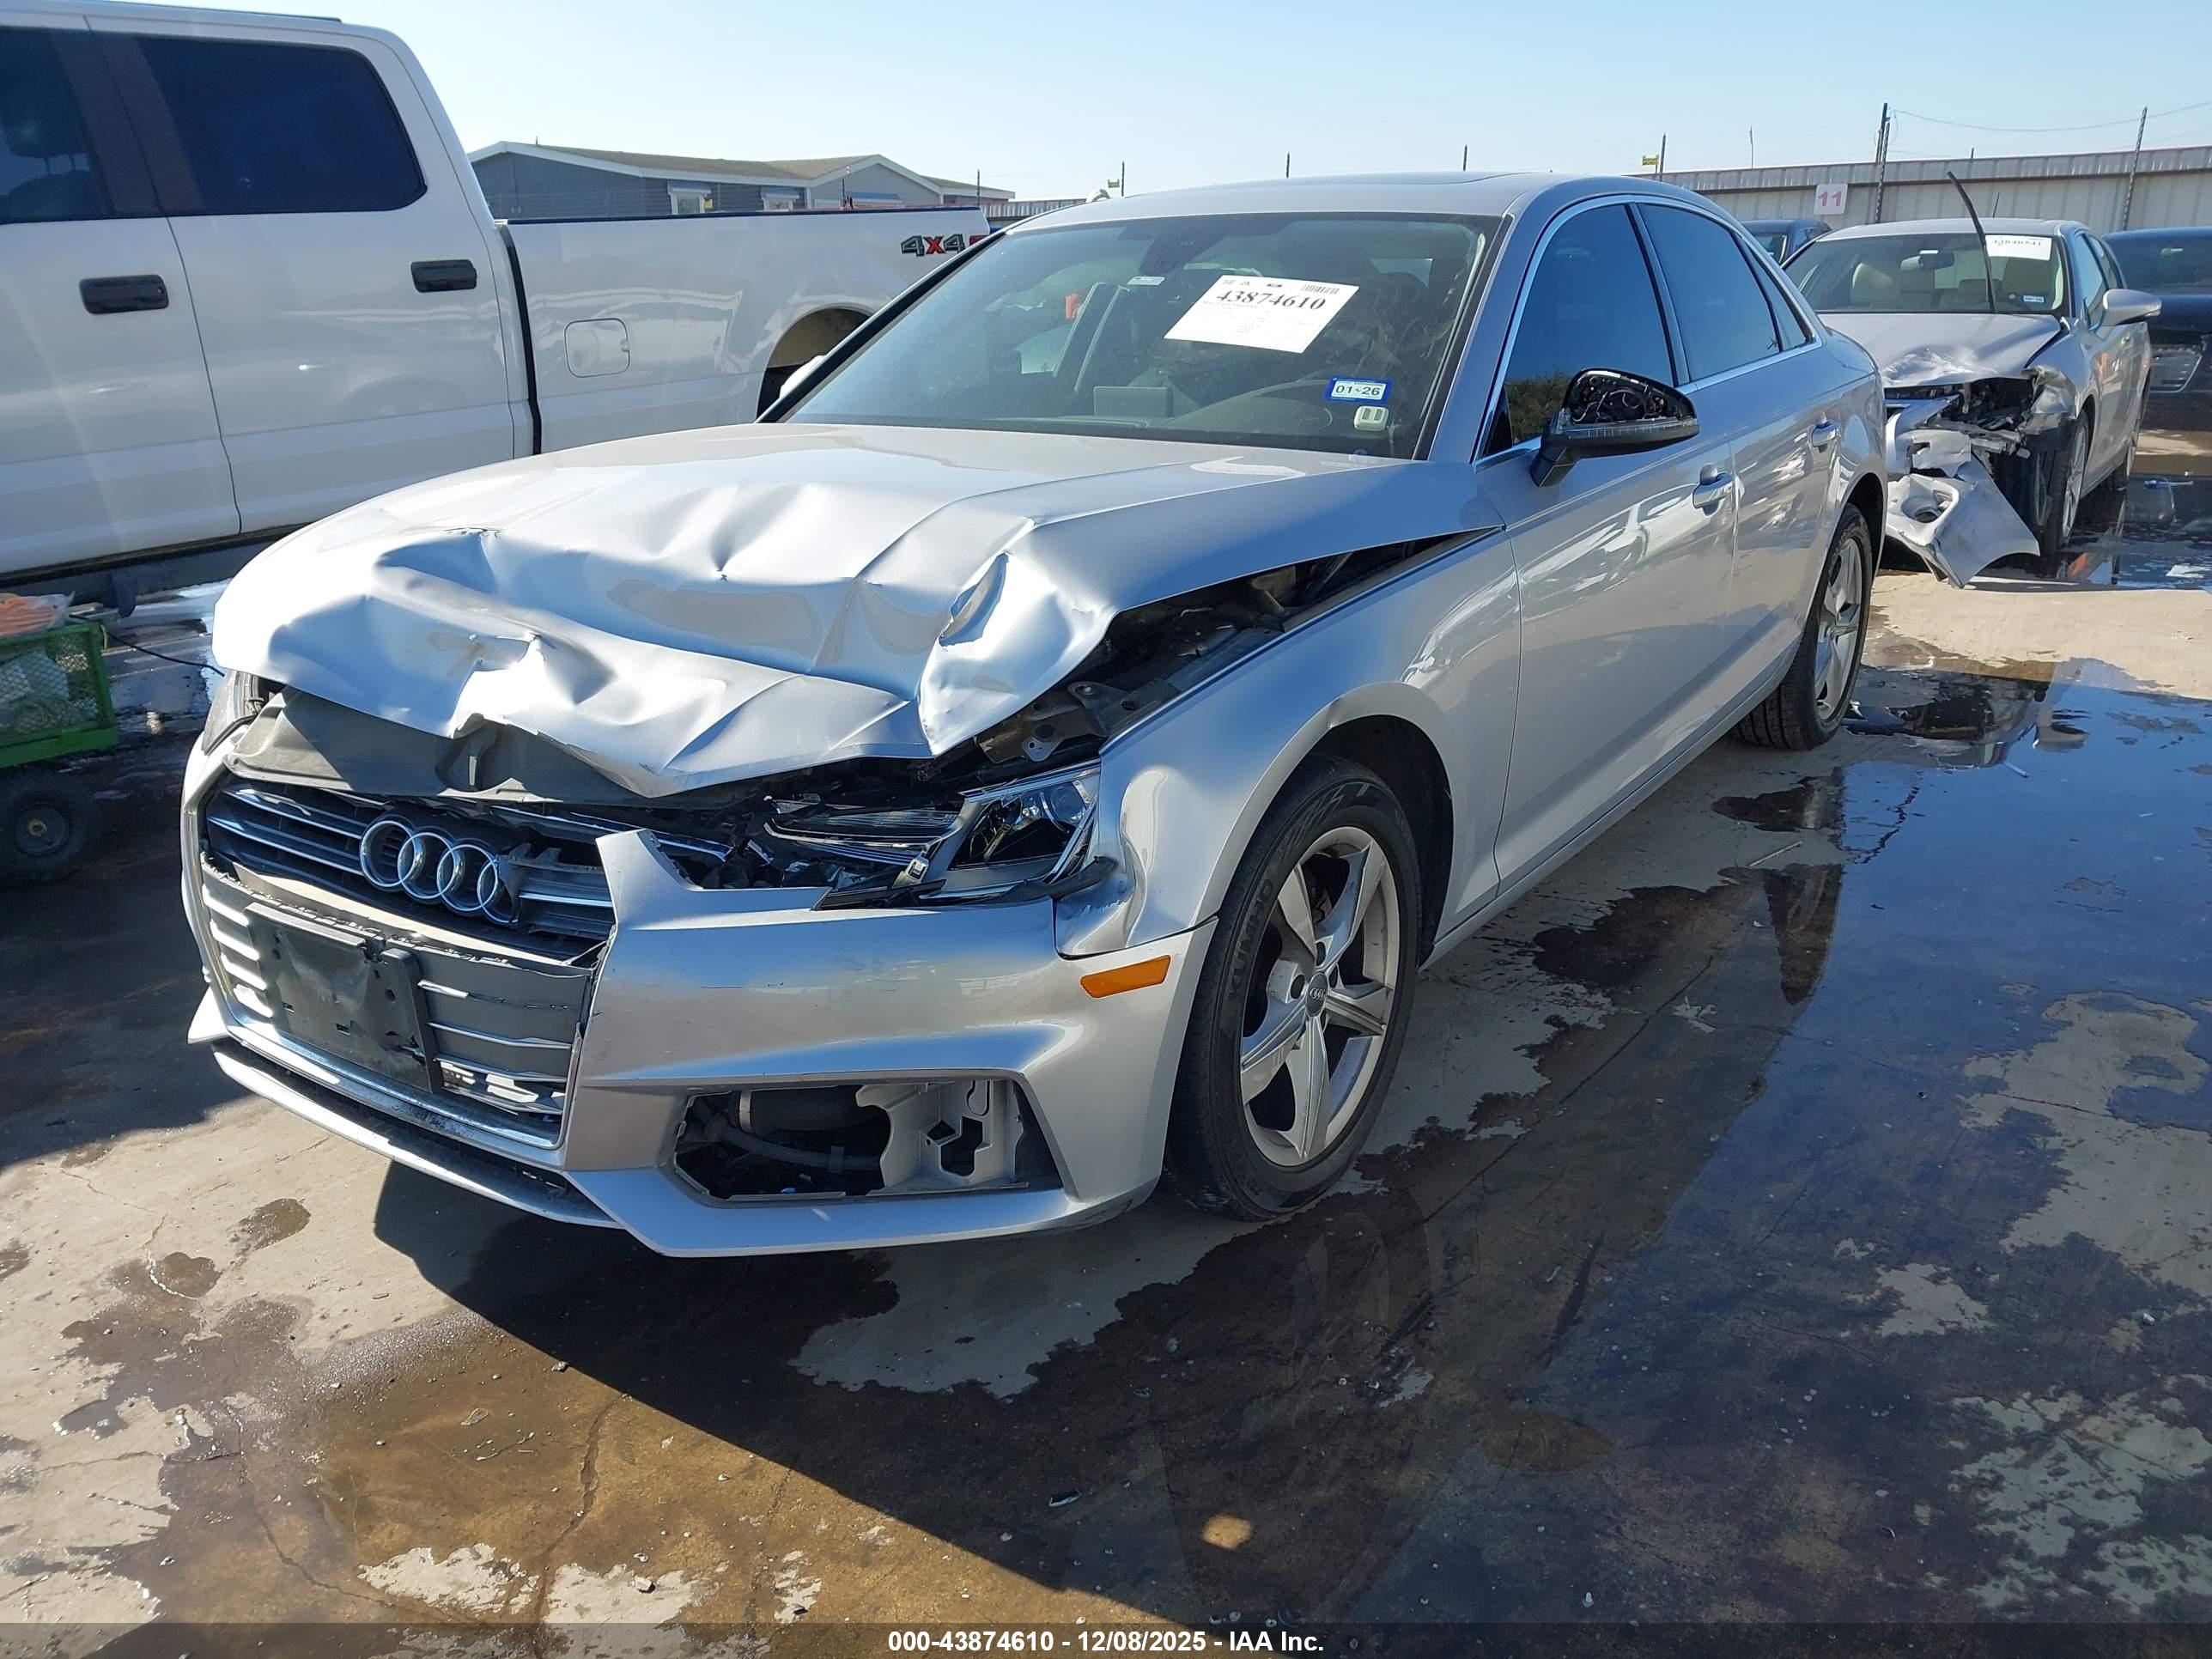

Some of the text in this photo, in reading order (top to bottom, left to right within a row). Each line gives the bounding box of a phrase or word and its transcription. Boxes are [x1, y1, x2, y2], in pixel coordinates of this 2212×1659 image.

[1818, 191, 1842, 207] 11
[1215, 289, 1327, 310] 43874610
[1228, 878, 1274, 999] KUMHO
